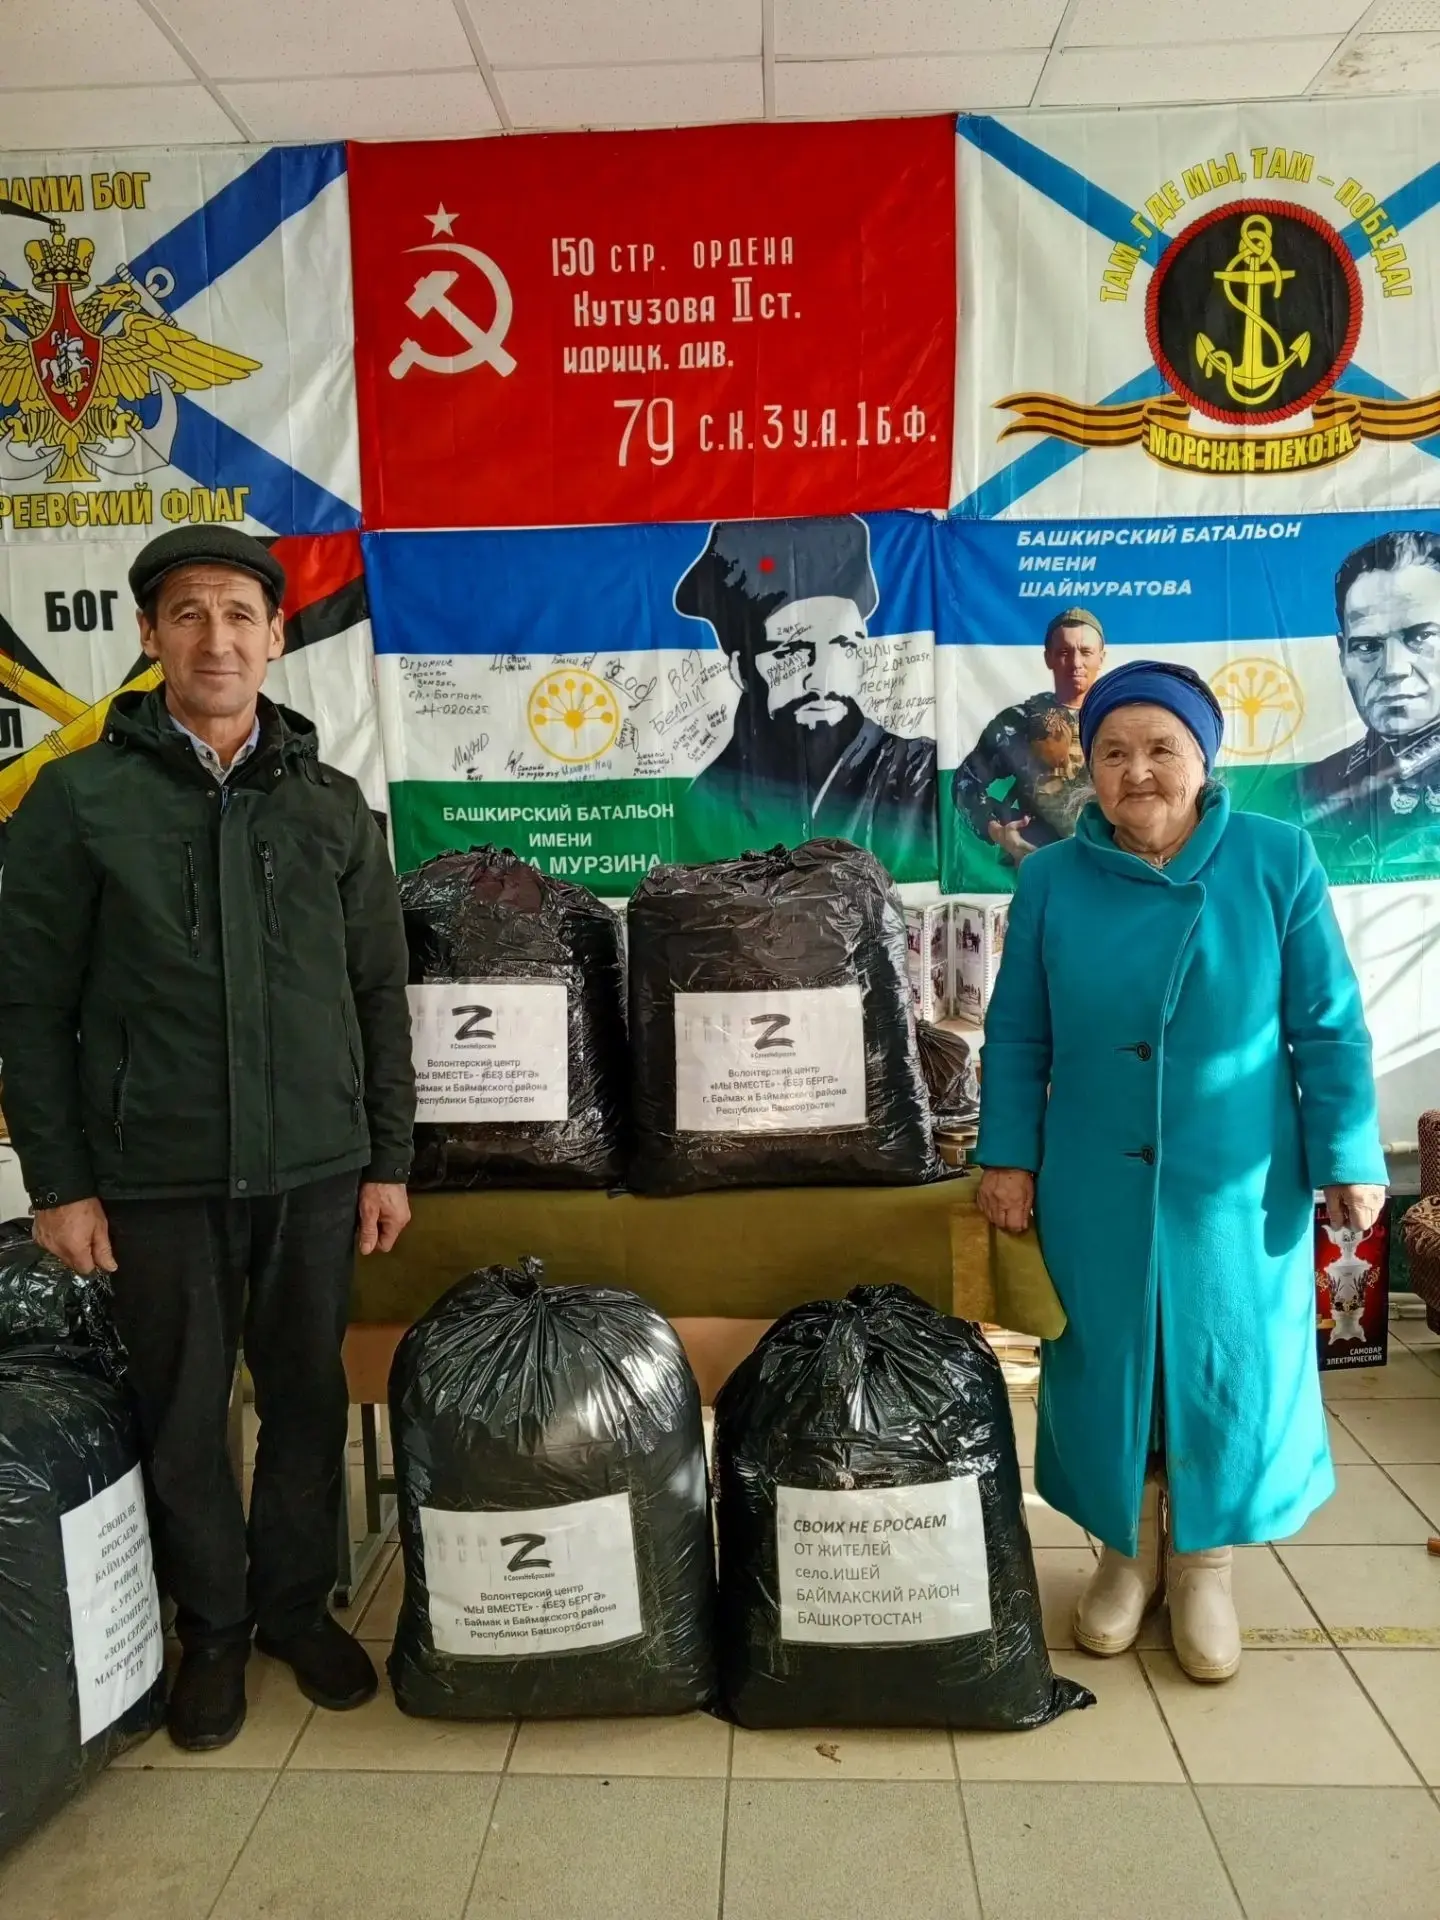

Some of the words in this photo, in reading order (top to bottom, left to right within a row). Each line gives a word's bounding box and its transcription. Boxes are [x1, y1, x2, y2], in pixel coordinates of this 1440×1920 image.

[91, 171, 150, 210] БОГ
[1100, 241, 1148, 302] ТАМ,
[1130, 181, 1186, 239] ГДЕ
[1181, 152, 1247, 200] МЫ,
[1250, 147, 1314, 183] ТАМ
[1334, 177, 1412, 298] ПОБЕДА!
[552, 237, 594, 276] 150
[610, 243, 667, 273] СТР.
[693, 236, 794, 269] ОРДЕНА
[679, 340, 735, 370] ДИВ.
[613, 397, 675, 467] 79
[763, 404, 784, 449] 3
[1149, 422, 1256, 472] МОРСКАЯ
[1264, 422, 1355, 471] ПЕХОТА
[161, 487, 250, 523] ФЛАГ
[1016, 525, 1176, 546] БАШКИРСКИЙ
[1180, 522, 1302, 544] БАТАЛЬОН
[1018, 556, 1097, 571] ИМЕНИ
[1019, 578, 1192, 597] ШАЙМУРАТОВА
[44, 590, 118, 633] БОГ
[443, 804, 572, 821] БАШКИРСКИЙ
[577, 803, 674, 821] БАТАЛЬОН
[529, 833, 592, 847] ИМЕНИ
[549, 854, 661, 874] МУРЗИНА
[427, 1058, 492, 1069] Волонтерский
[494, 1059, 521, 1069] центр
[728, 1068, 793, 1079] Волонтерский
[794, 1066, 821, 1076] центр
[415, 1071, 430, 1079] МЫ
[416, 1084, 443, 1092] аймак
[453, 1084, 513, 1092] Баймакского
[515, 1083, 547, 1093] района
[711, 1094, 745, 1103] Баймак
[815, 1088, 847, 1099] района
[469, 1096, 535, 1105] Башкортостан
[716, 1105, 769, 1116] Республики
[772, 1101, 836, 1112] Башкортостан
[1326, 1353, 1383, 1366] ЭЛЕКТРИЧЕСКИЙ
[1349, 1346, 1383, 1356] САМОВАР
[793, 1520, 845, 1533] СВОИХ
[849, 1520, 868, 1533] НЕ
[872, 1514, 947, 1533] БРОСАЕМ
[794, 1542, 813, 1556] ОТ
[818, 1540, 891, 1557] ЖИТЕЛЕЙ
[480, 1588, 552, 1601] Волонтерский
[554, 1584, 584, 1597] центр
[796, 1586, 904, 1604] БАЙМАКСКИЙ
[908, 1584, 960, 1602] РАЙОН
[464, 1605, 485, 1614] «МЫ
[487, 1602, 533, 1614] ВМЕСТЕ»
[464, 1616, 501, 1626] Баймак
[512, 1611, 579, 1625] Баймакского
[581, 1602, 617, 1618] района
[798, 1611, 922, 1626] БАШКОРТОСТАН
[470, 1627, 529, 1640] Республики
[531, 1619, 604, 1636] Башкортостан
